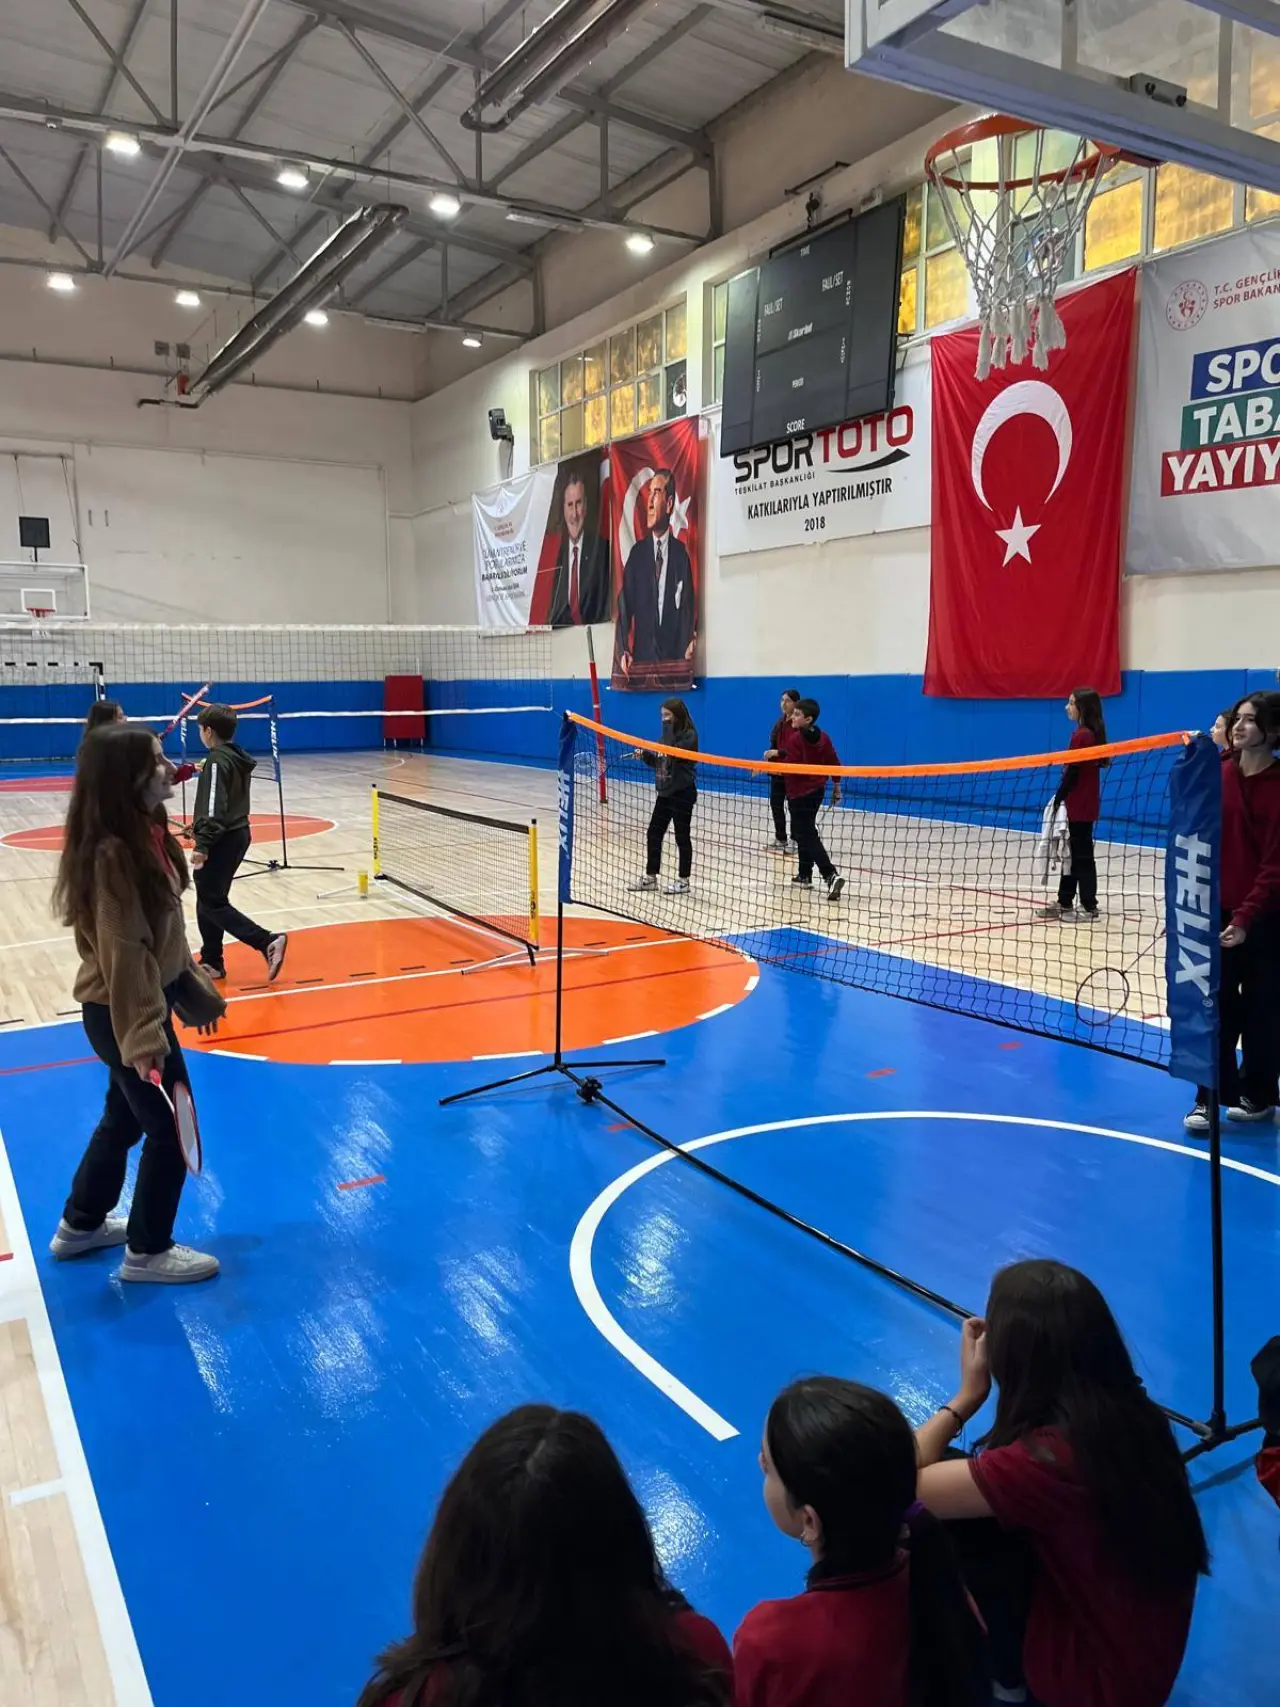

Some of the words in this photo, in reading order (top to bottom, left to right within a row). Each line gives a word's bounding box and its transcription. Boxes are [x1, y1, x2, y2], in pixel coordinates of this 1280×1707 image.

[1214, 282, 1233, 296] T.C.
[1213, 293, 1241, 309] SPOR
[786, 418, 805, 434] SCORE
[1193, 396, 1280, 445] TAB
[747, 494, 810, 520] KATKILARIYLA
[813, 477, 893, 508] YAPTIRILMIŞTIR
[804, 516, 826, 532] 2018
[1175, 832, 1212, 997] HELIX
